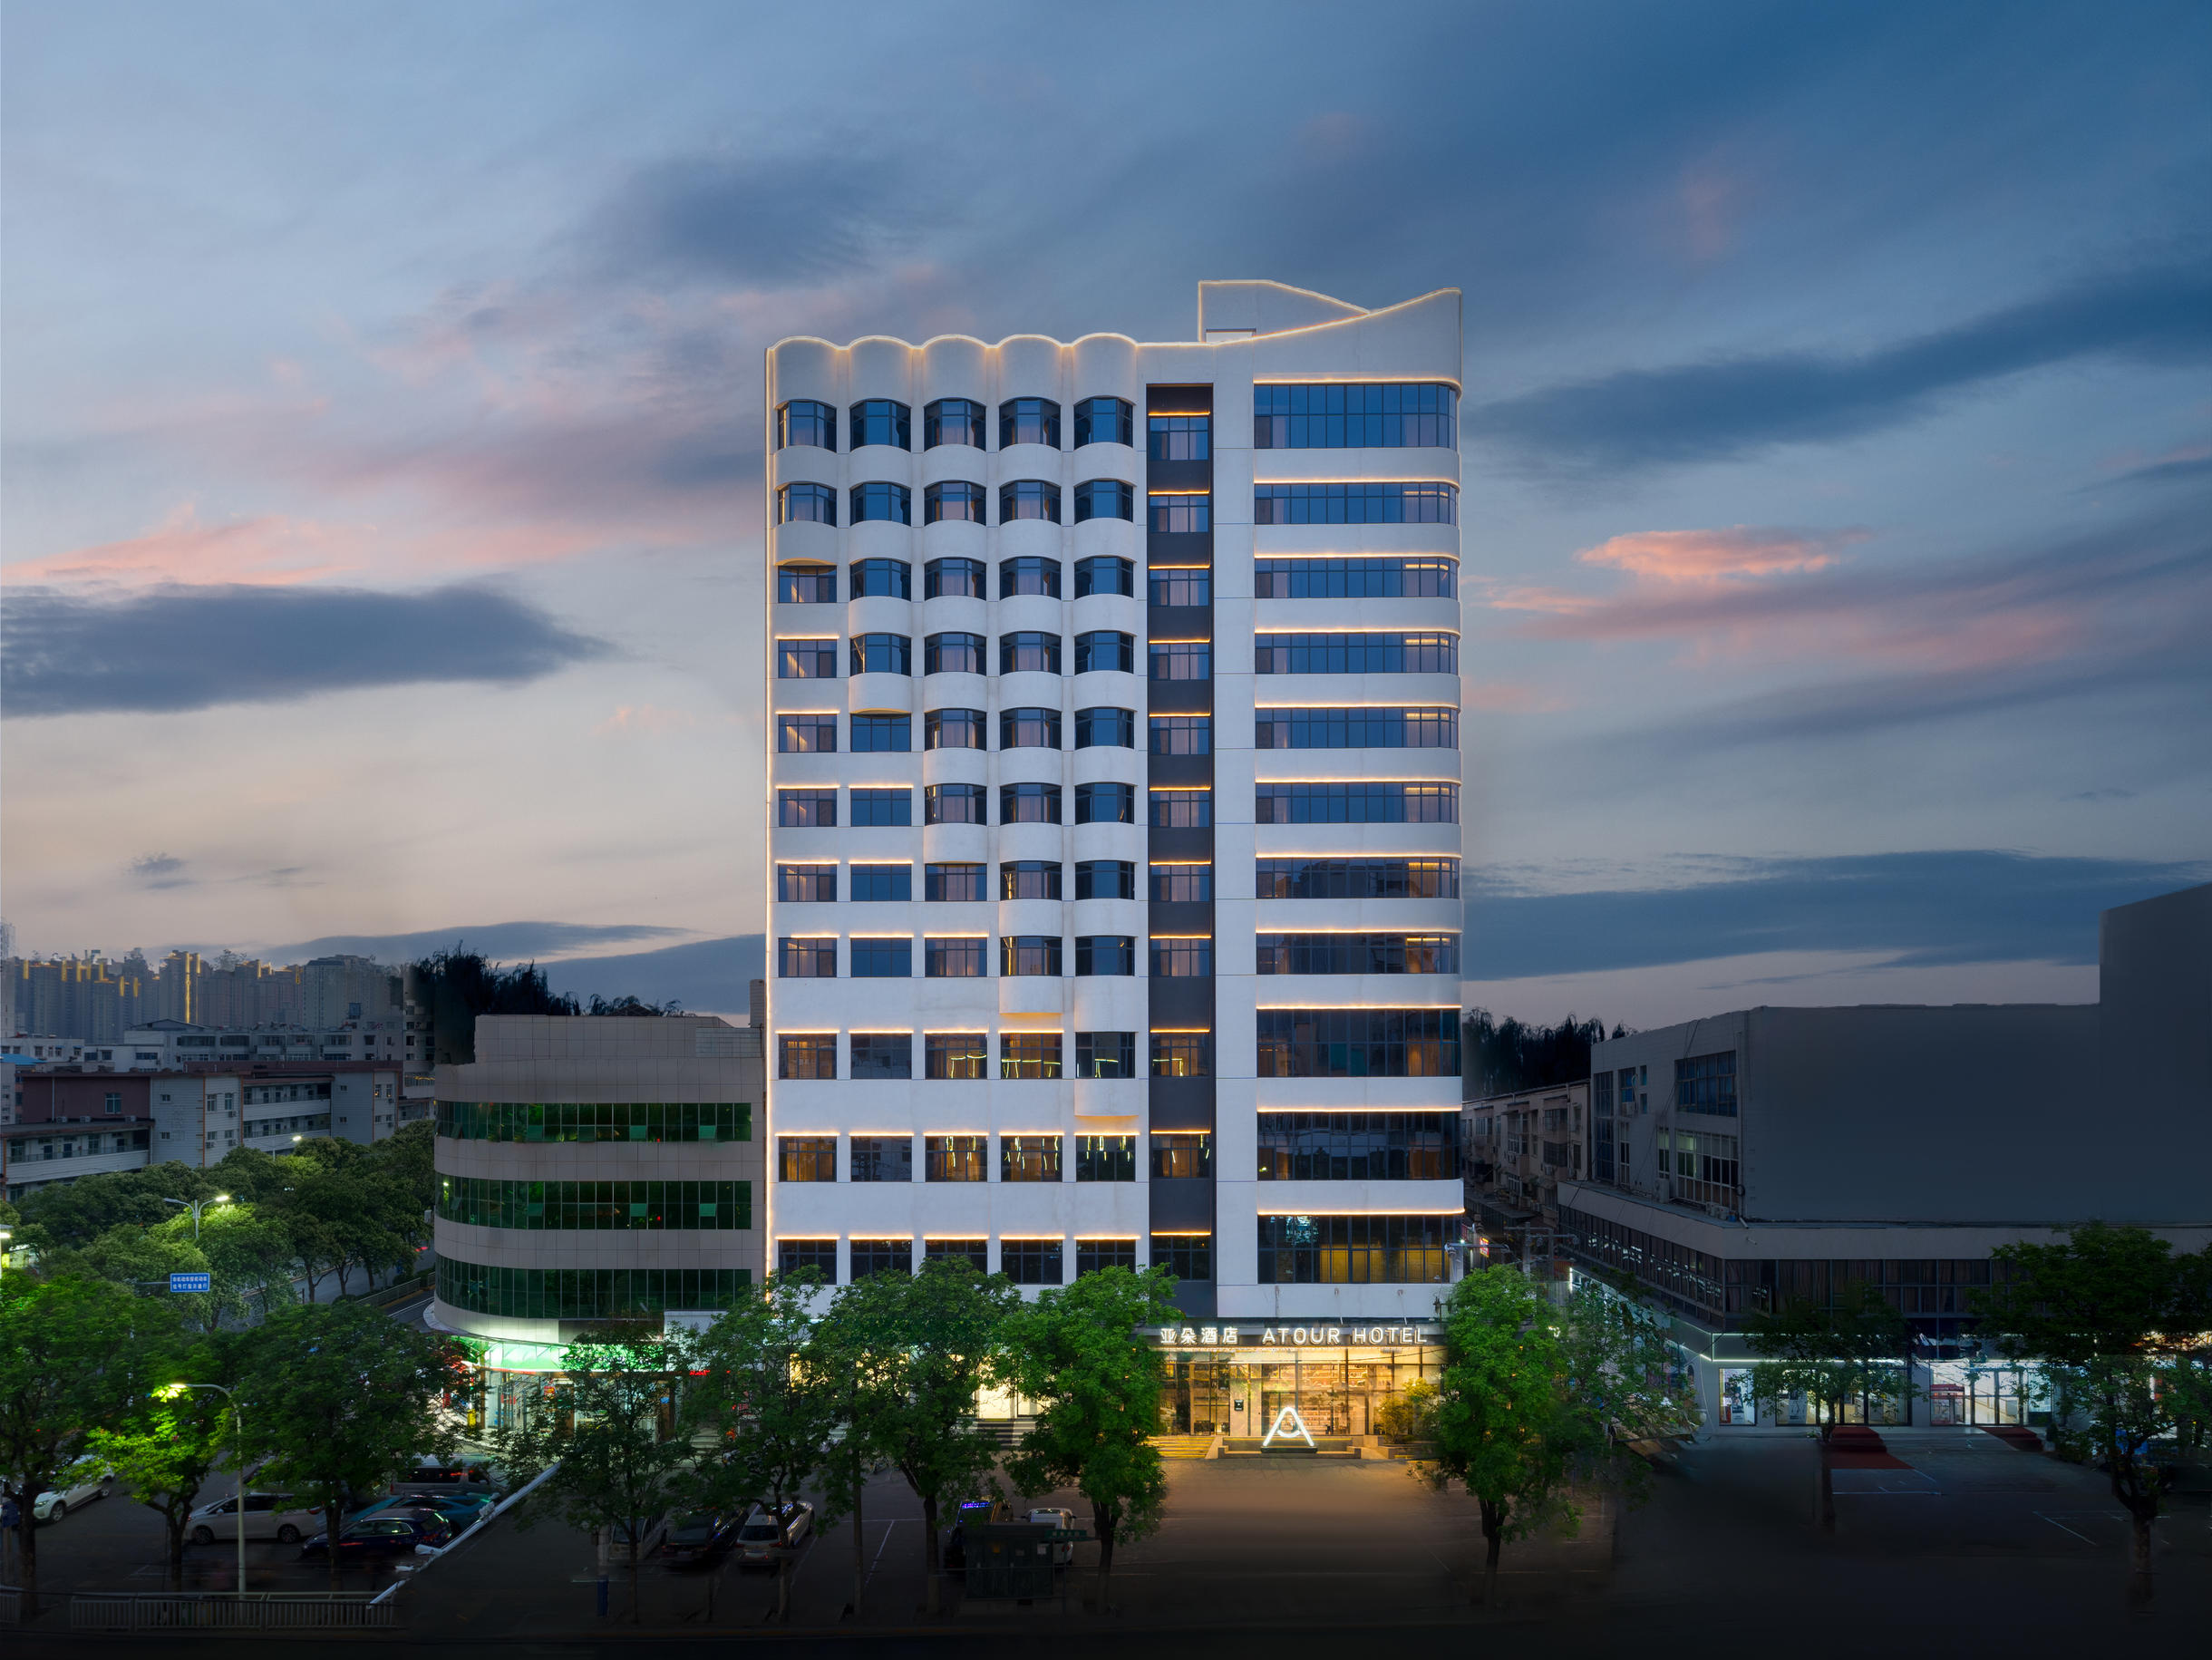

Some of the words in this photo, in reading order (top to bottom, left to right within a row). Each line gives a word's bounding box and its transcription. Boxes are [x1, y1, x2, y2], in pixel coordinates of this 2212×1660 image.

[1160, 1326, 1238, 1345] 亚朵酒店
[1262, 1327, 1340, 1345] ATOUR
[1353, 1327, 1427, 1345] HOTEL
